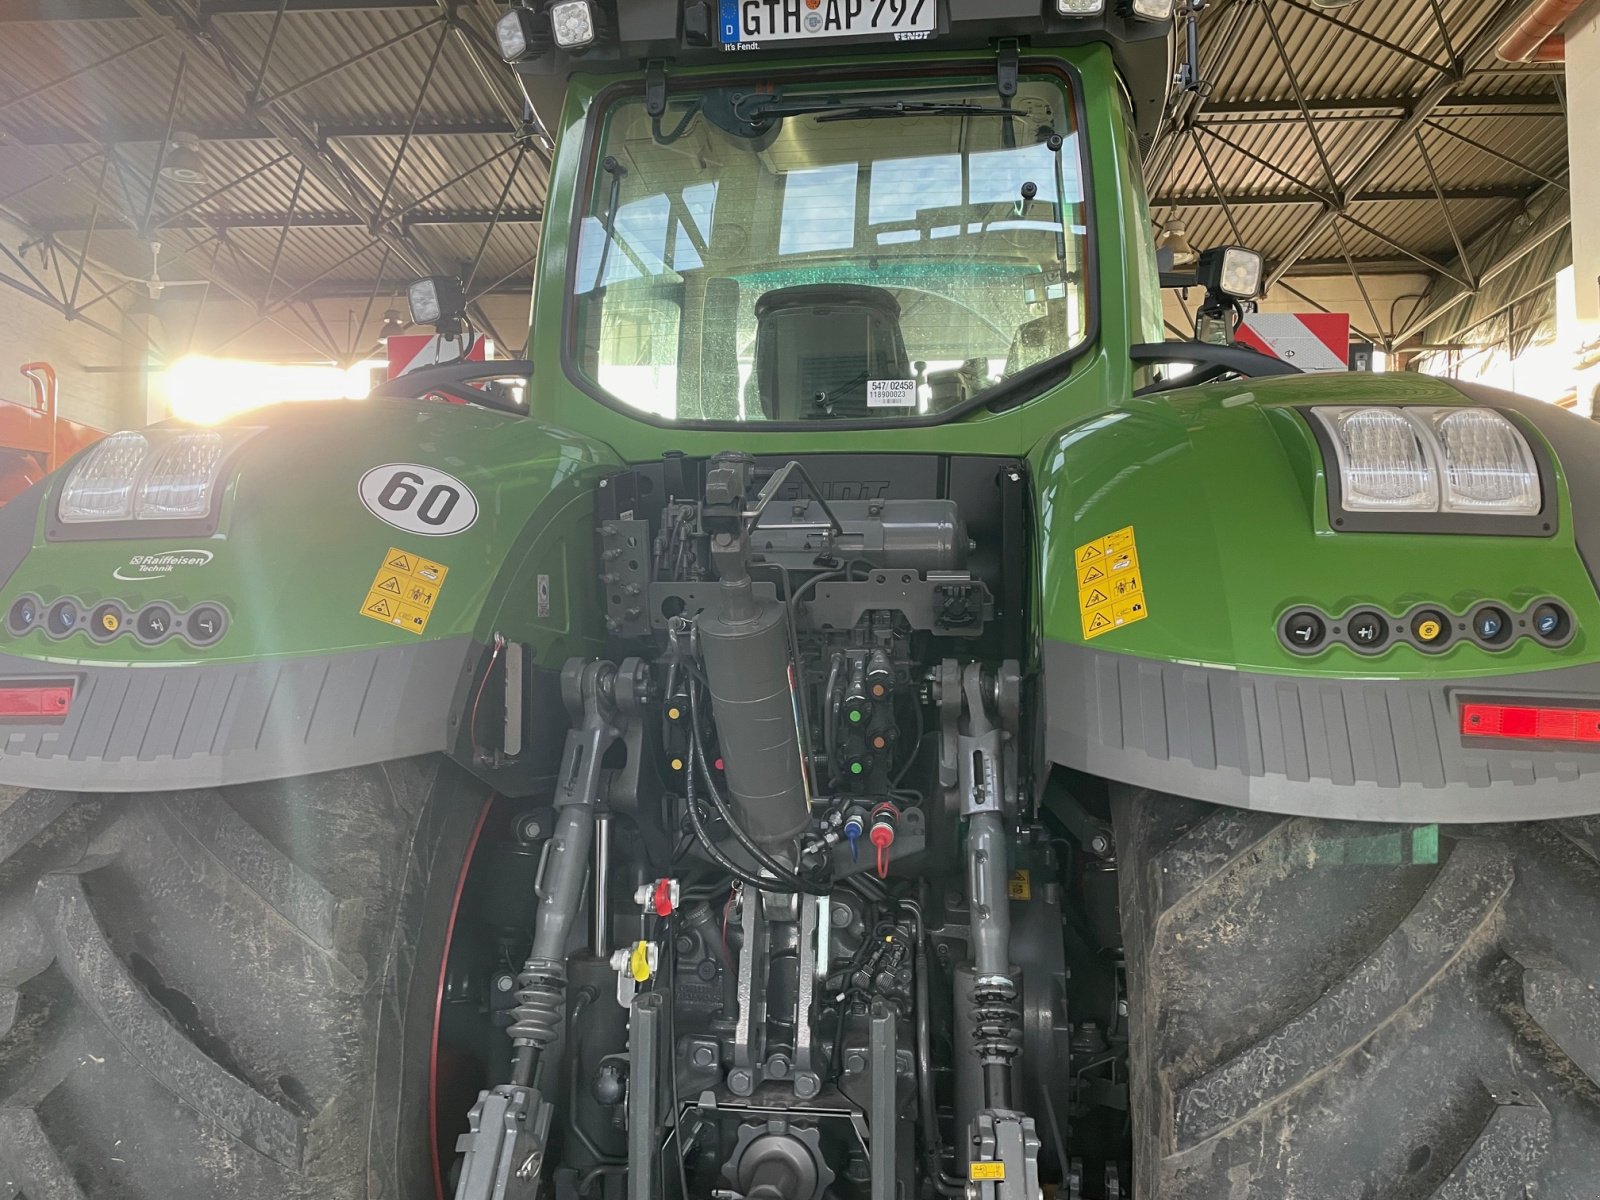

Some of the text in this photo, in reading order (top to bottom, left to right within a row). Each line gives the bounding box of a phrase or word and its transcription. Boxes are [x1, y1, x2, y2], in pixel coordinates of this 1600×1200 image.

[743, 0, 926, 35] GTH AP 797
[726, 25, 734, 35] D
[894, 31, 931, 41] FENDT
[725, 43, 736, 51] It's
[378, 471, 460, 526] 60
[142, 555, 205, 565] Raiffeisen
